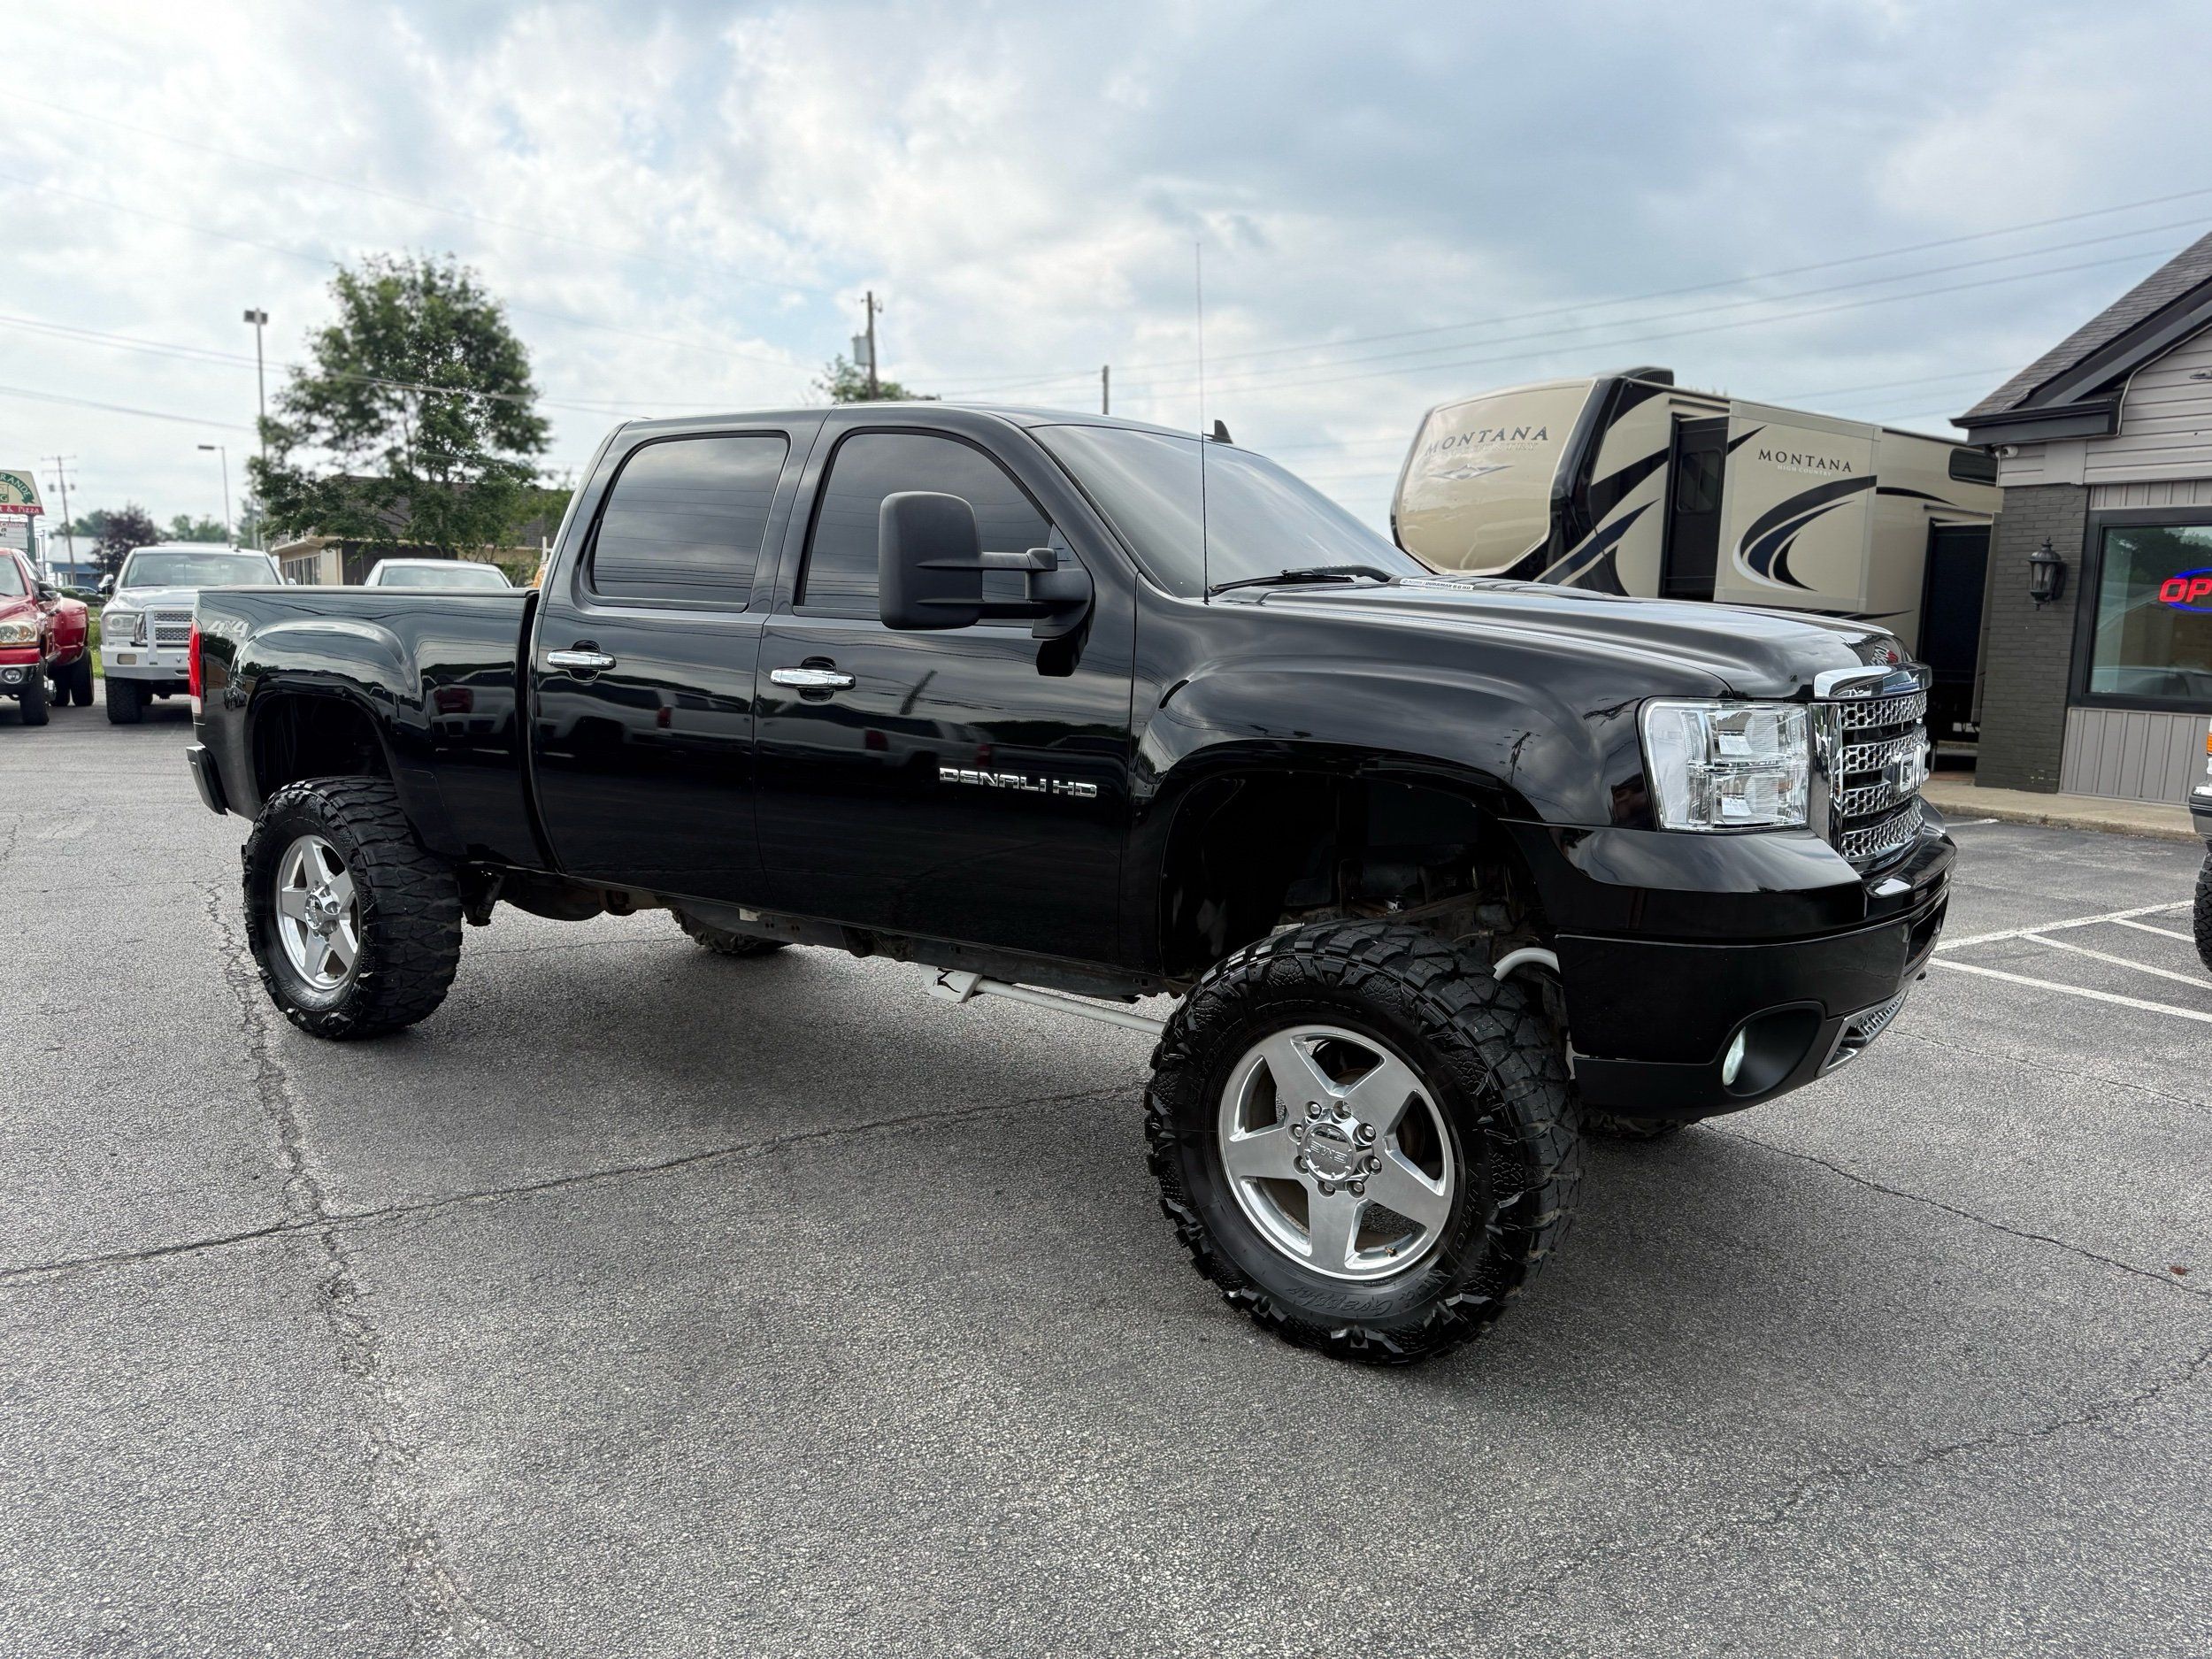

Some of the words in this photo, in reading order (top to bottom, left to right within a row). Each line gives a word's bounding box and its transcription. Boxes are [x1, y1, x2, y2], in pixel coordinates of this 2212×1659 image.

[1425, 426, 1548, 457] MONTANA
[1758, 449, 1852, 472] MONTANA
[1798, 467, 1832, 477] COUNTRY
[940, 767, 1047, 793] DENALI
[1053, 780, 1097, 798] HD
